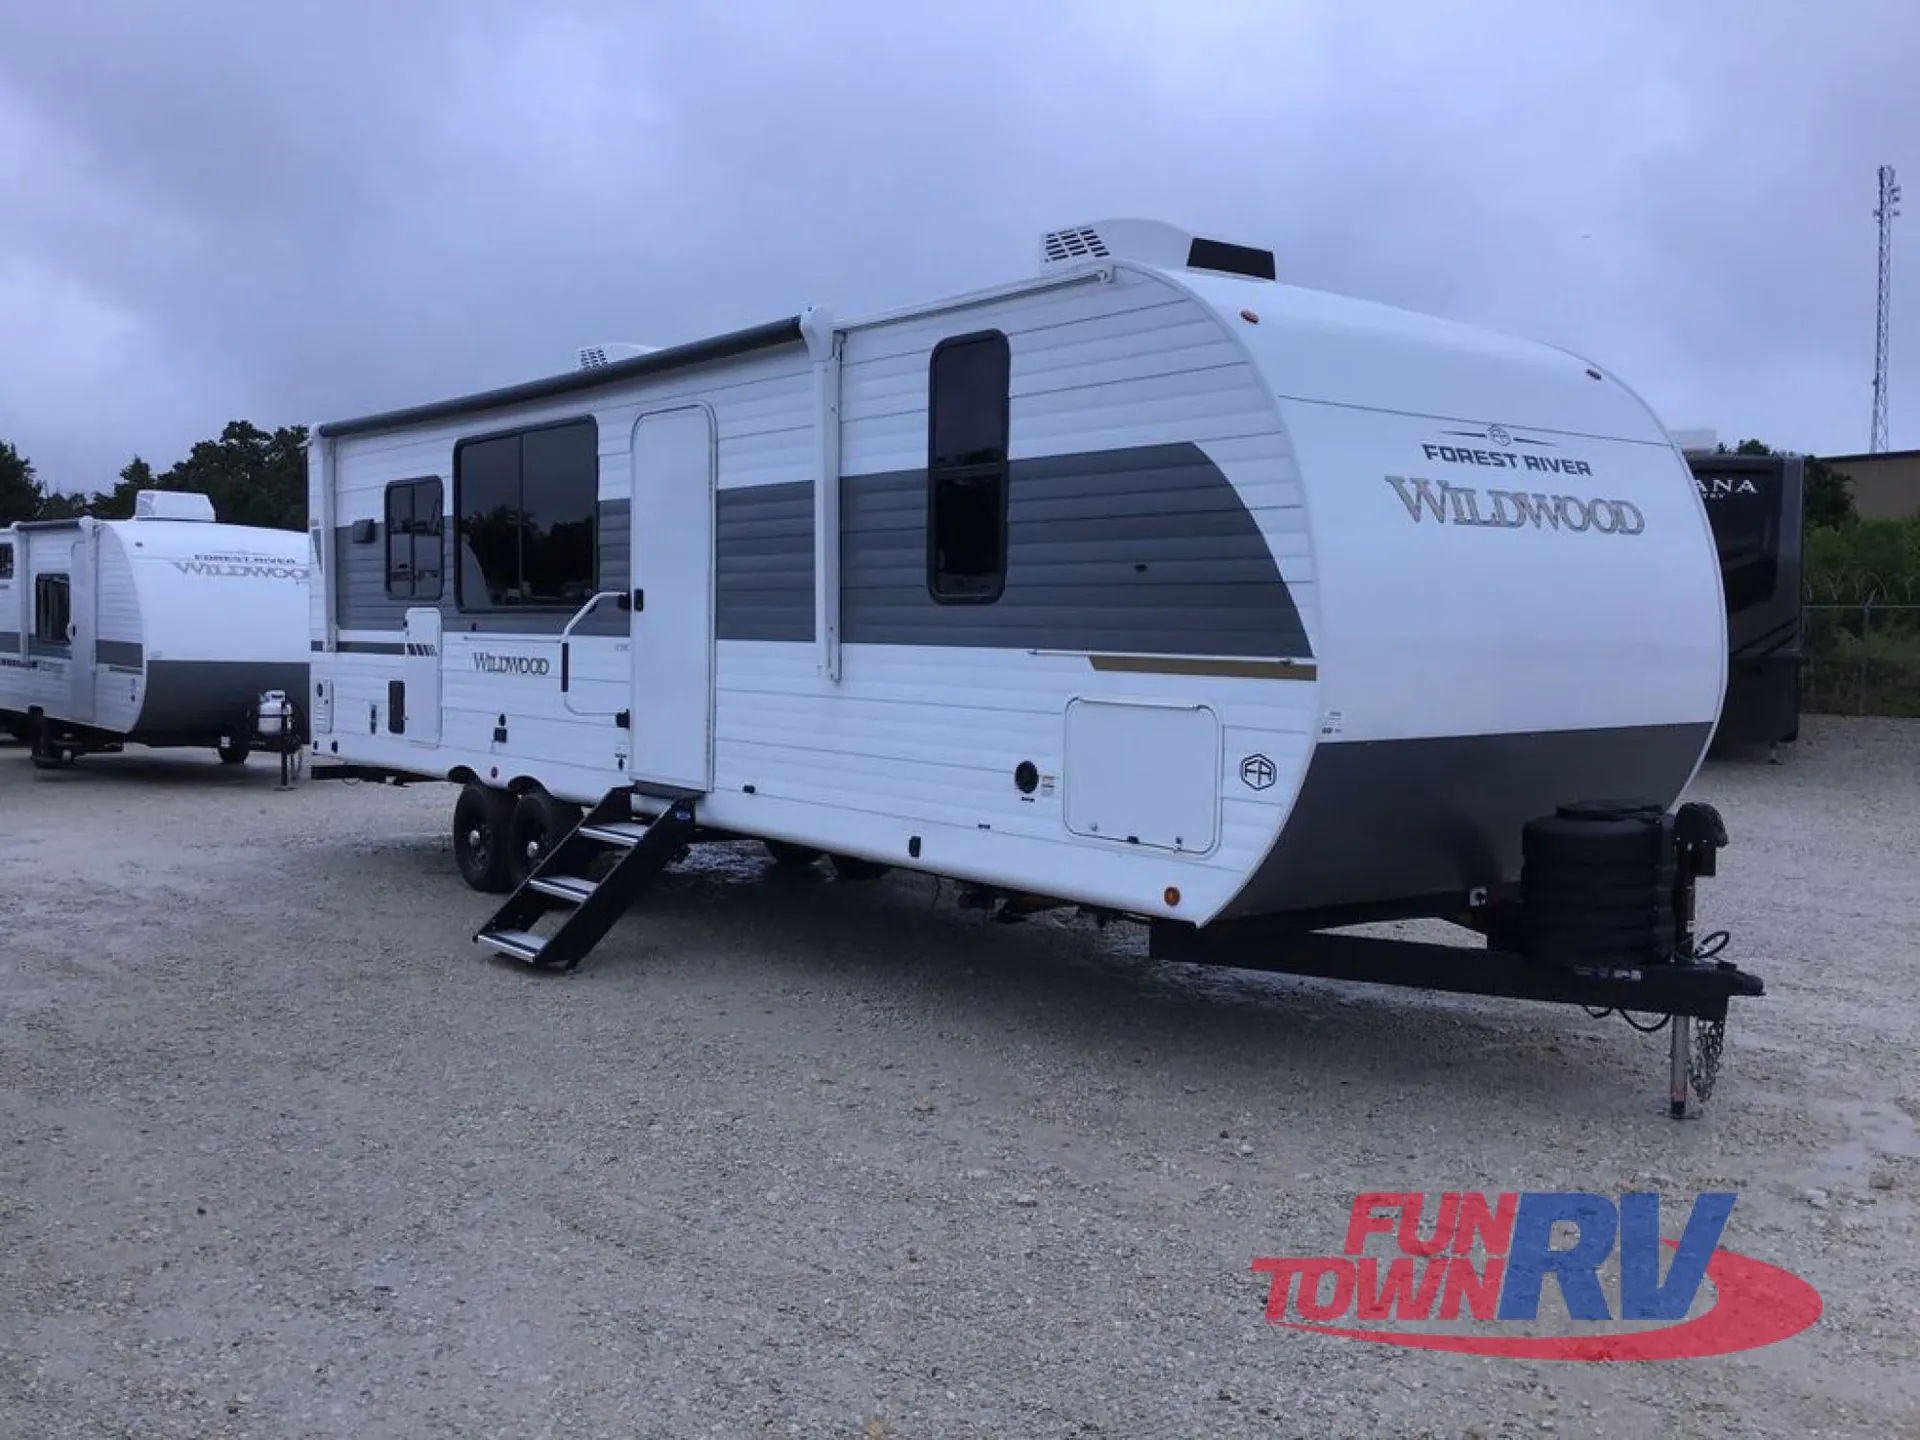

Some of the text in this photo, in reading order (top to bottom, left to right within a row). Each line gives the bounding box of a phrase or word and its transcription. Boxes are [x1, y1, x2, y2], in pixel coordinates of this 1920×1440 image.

[1421, 444, 1592, 475] FOREST RIVER
[1384, 475, 1645, 535] WILDWOOD
[472, 652, 550, 676] WILDWOOD
